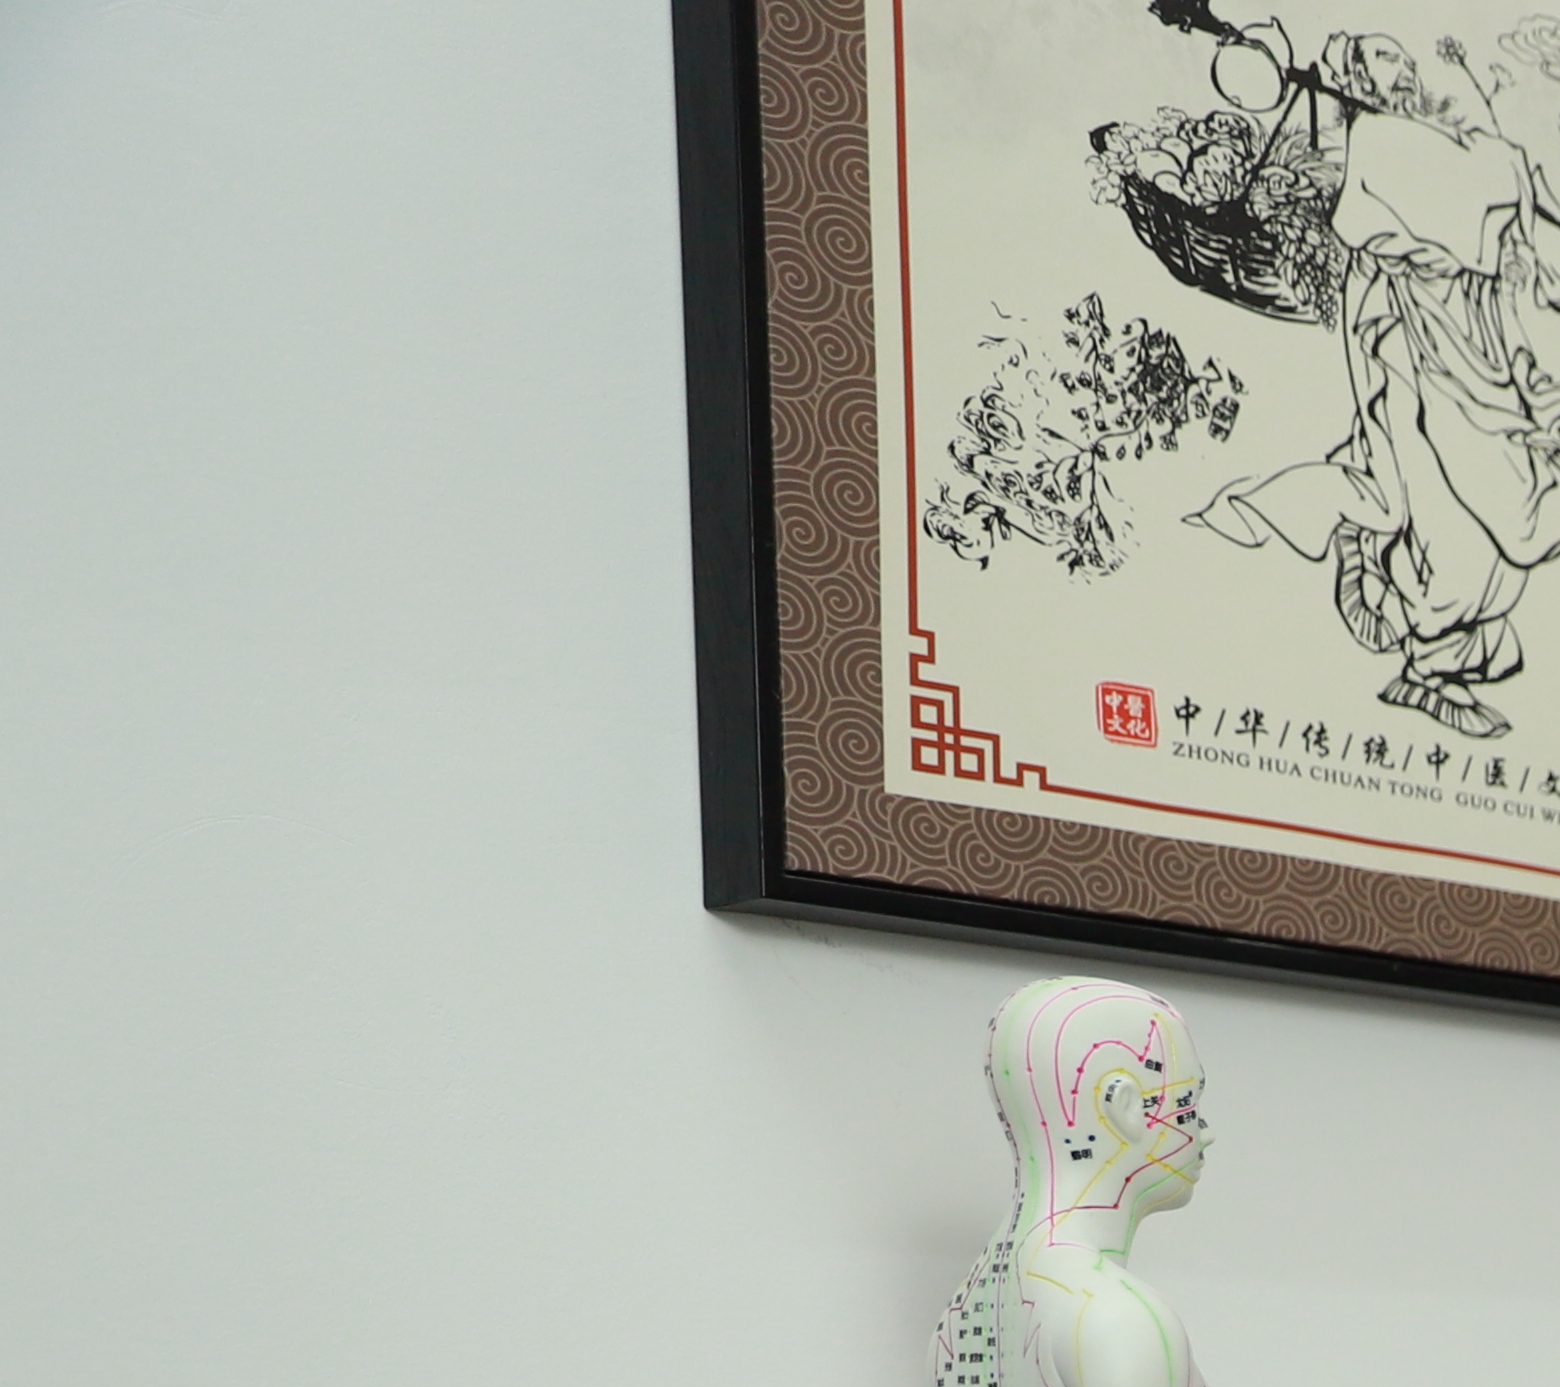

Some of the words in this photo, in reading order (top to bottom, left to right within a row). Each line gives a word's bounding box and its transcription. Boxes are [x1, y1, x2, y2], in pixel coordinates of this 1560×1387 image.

[1106, 713, 1150, 739] 文化
[1172, 741, 1251, 768] ZHONG
[1259, 756, 1302, 778] HUA
[1310, 765, 1381, 792] CHUAN
[1388, 780, 1444, 803] TONG
[1455, 791, 1497, 812] GUO
[1503, 802, 1535, 821] CUI
